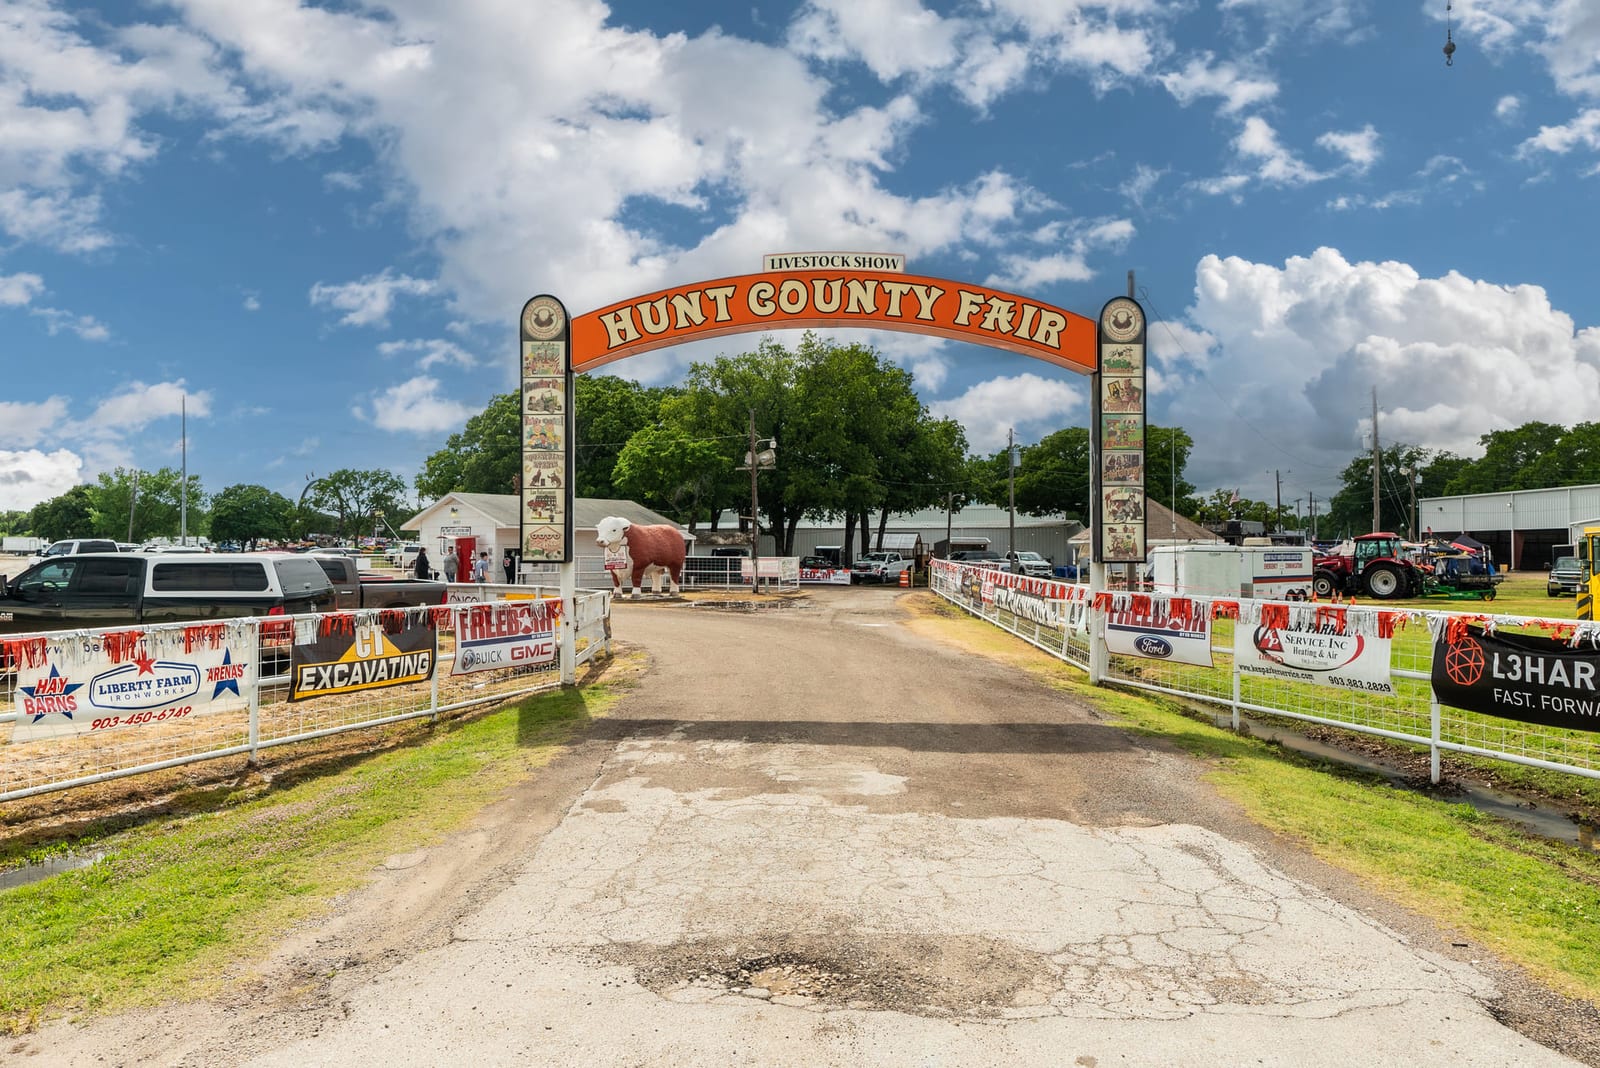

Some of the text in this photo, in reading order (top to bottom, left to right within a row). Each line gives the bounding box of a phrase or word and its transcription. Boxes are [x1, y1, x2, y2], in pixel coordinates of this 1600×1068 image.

[771, 256, 899, 269] LIVESTOCK SHOW
[599, 285, 736, 349] HUNT
[747, 278, 946, 321] COUNTY
[953, 290, 1067, 349] FAIR
[355, 624, 384, 658] CT
[1141, 638, 1165, 655] Ford
[1329, 638, 1348, 650] INC
[475, 650, 502, 664] BUICK
[511, 642, 552, 661] GMC
[1293, 647, 1338, 660] Heating & Air
[299, 652, 430, 692] EXCAVATING
[1492, 652, 1596, 691] L3HAR
[35, 677, 68, 695] HAY
[99, 675, 192, 695] LIBERTY FARM
[1328, 675, 1391, 693] 903.883.2829
[110, 687, 185, 702] IRONWORKS
[1493, 688, 1536, 709] FAST.
[24, 695, 78, 715] BARNS
[91, 706, 192, 730] 903-450-6749
